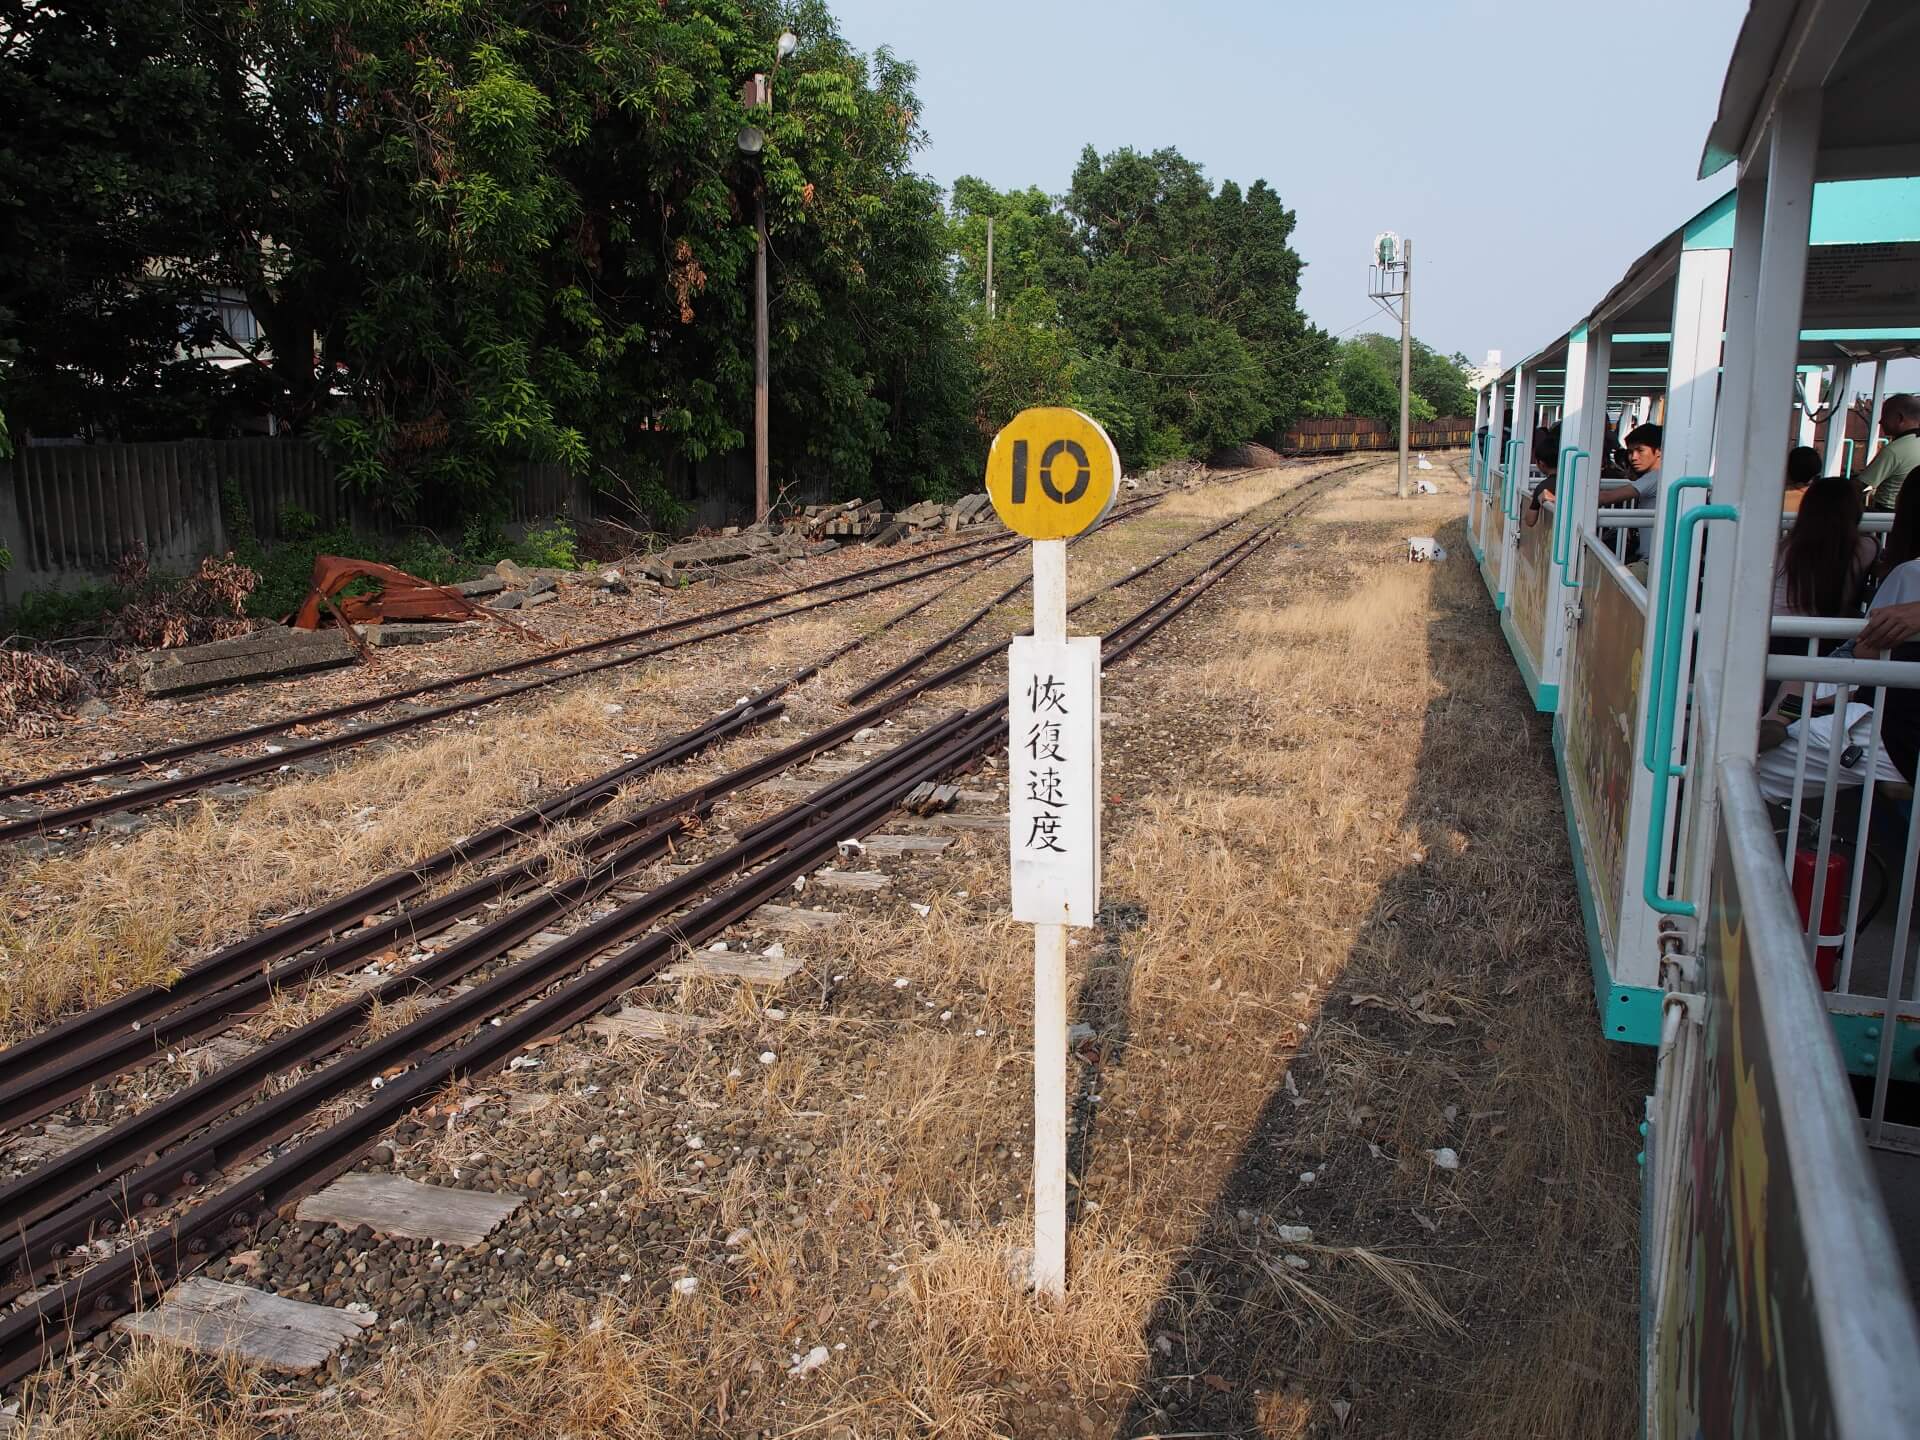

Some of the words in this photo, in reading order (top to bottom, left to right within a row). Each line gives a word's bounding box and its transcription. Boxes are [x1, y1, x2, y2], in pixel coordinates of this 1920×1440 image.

[1011, 439, 1091, 505] 10
[1025, 674, 1069, 853] 恢復速度
